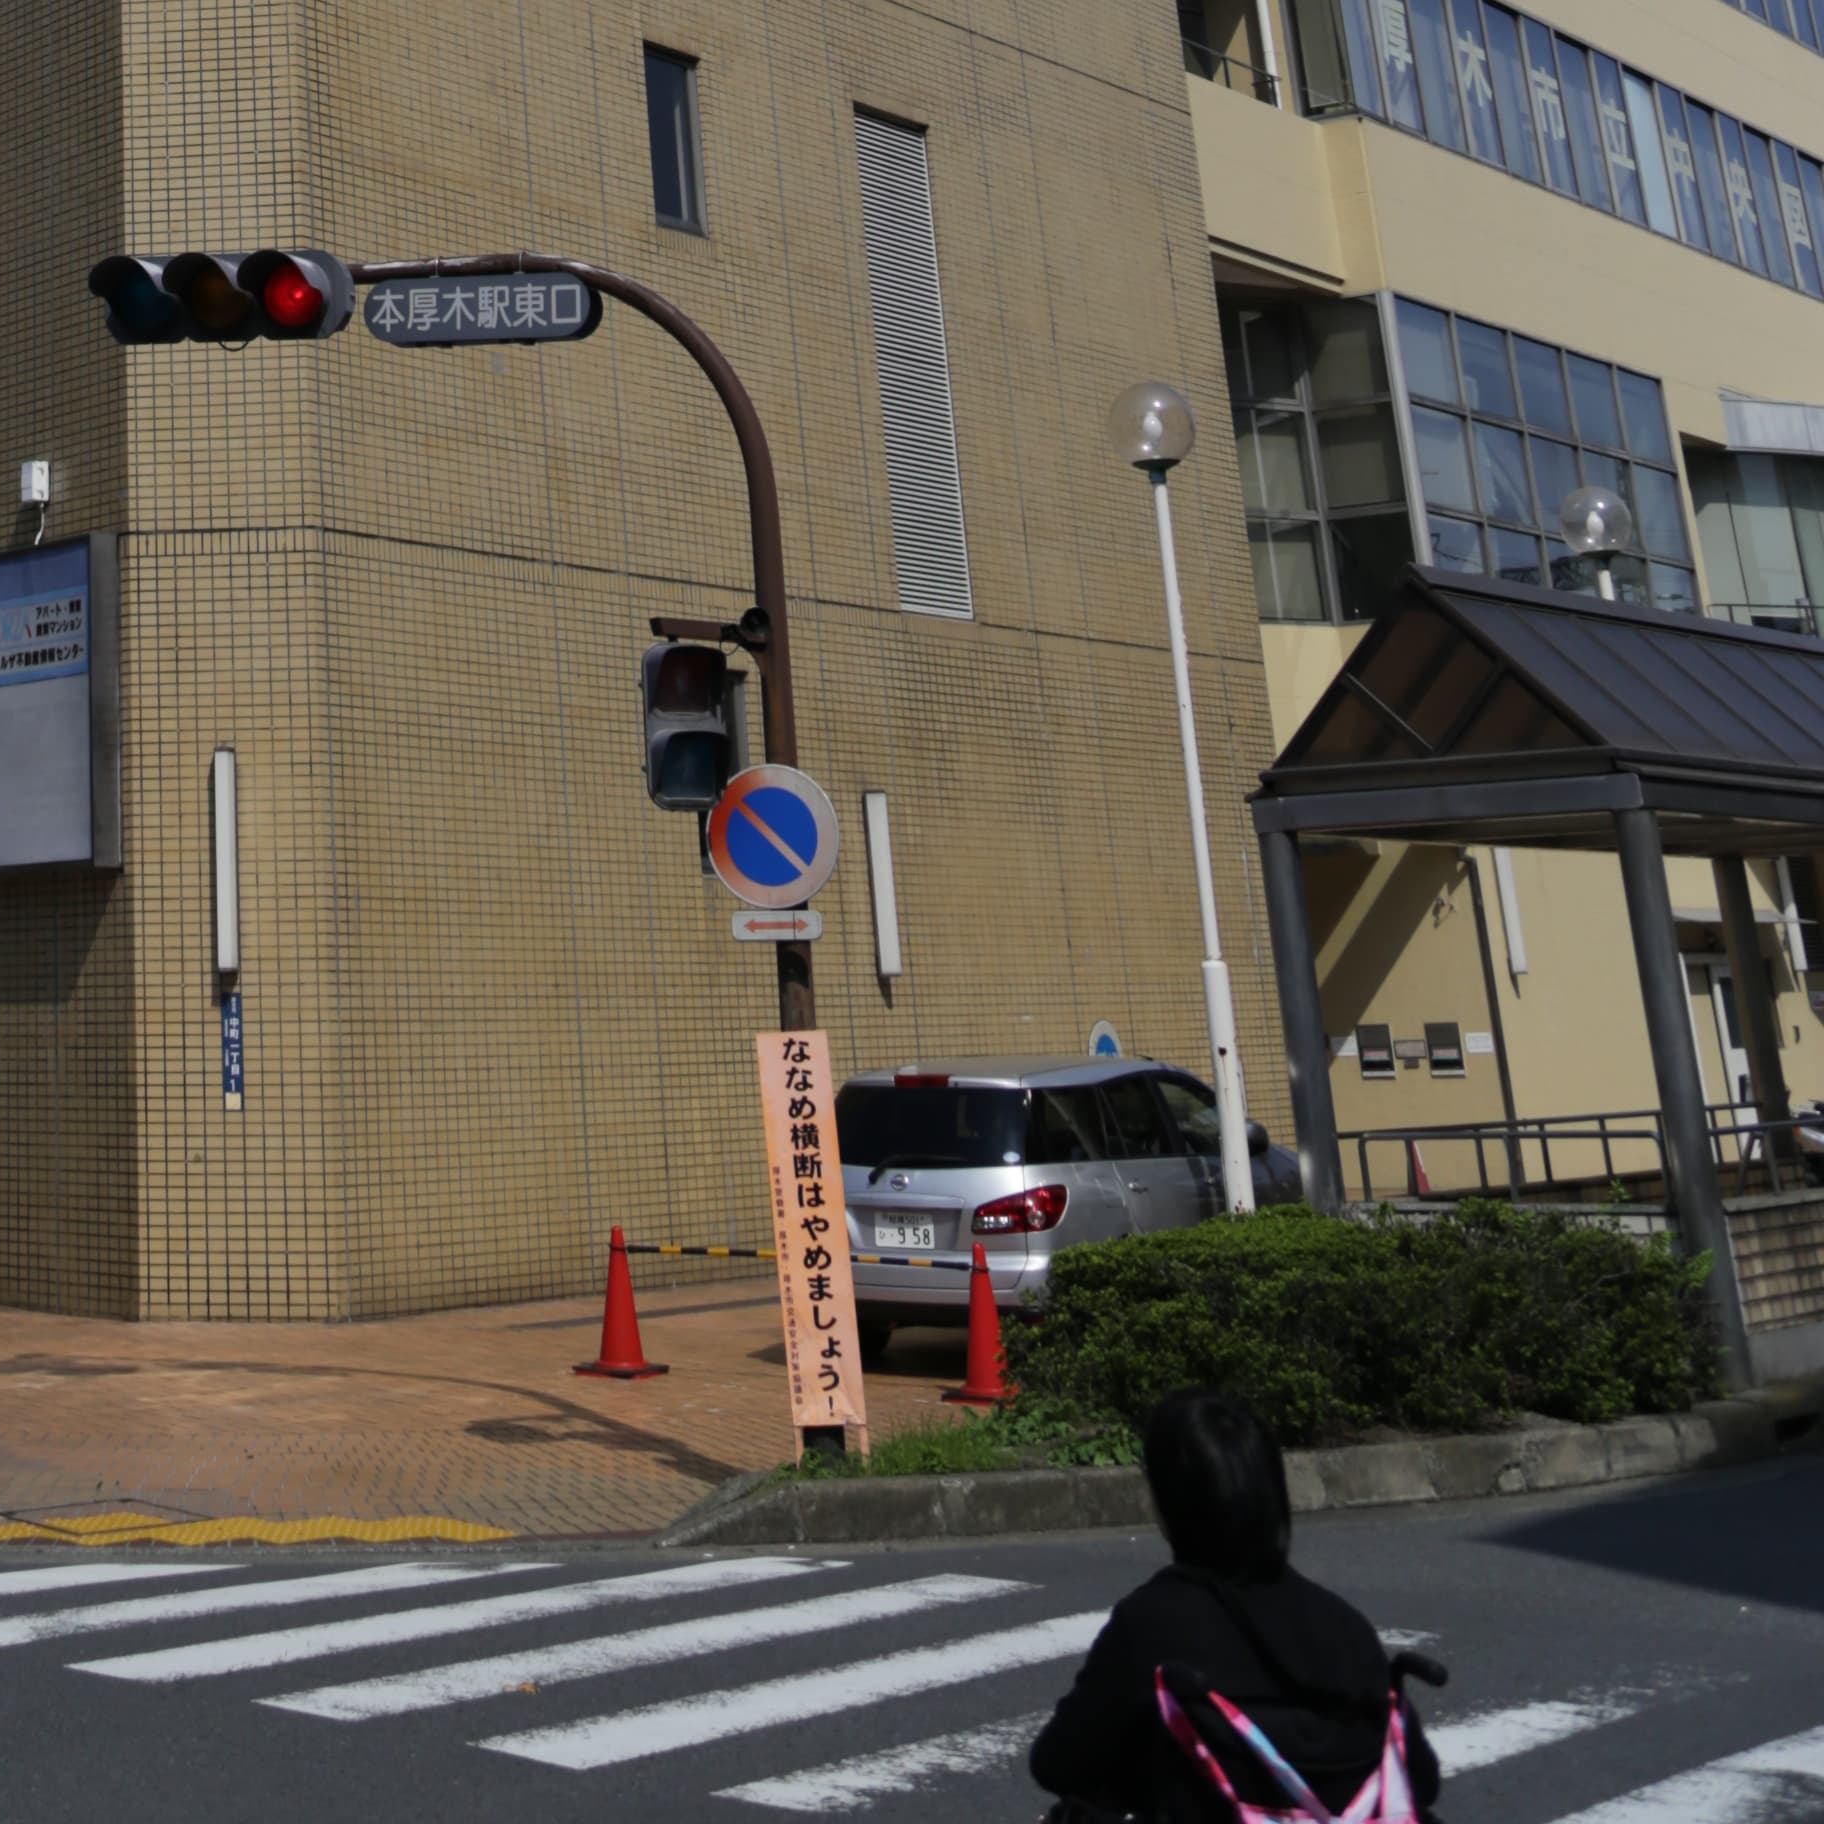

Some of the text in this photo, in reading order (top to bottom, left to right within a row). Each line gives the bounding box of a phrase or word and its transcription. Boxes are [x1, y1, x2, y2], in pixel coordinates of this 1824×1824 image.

[372, 283, 582, 333] 本厚木駅東口
[781, 1037, 842, 1417] ななめ横断はやめましょう!
